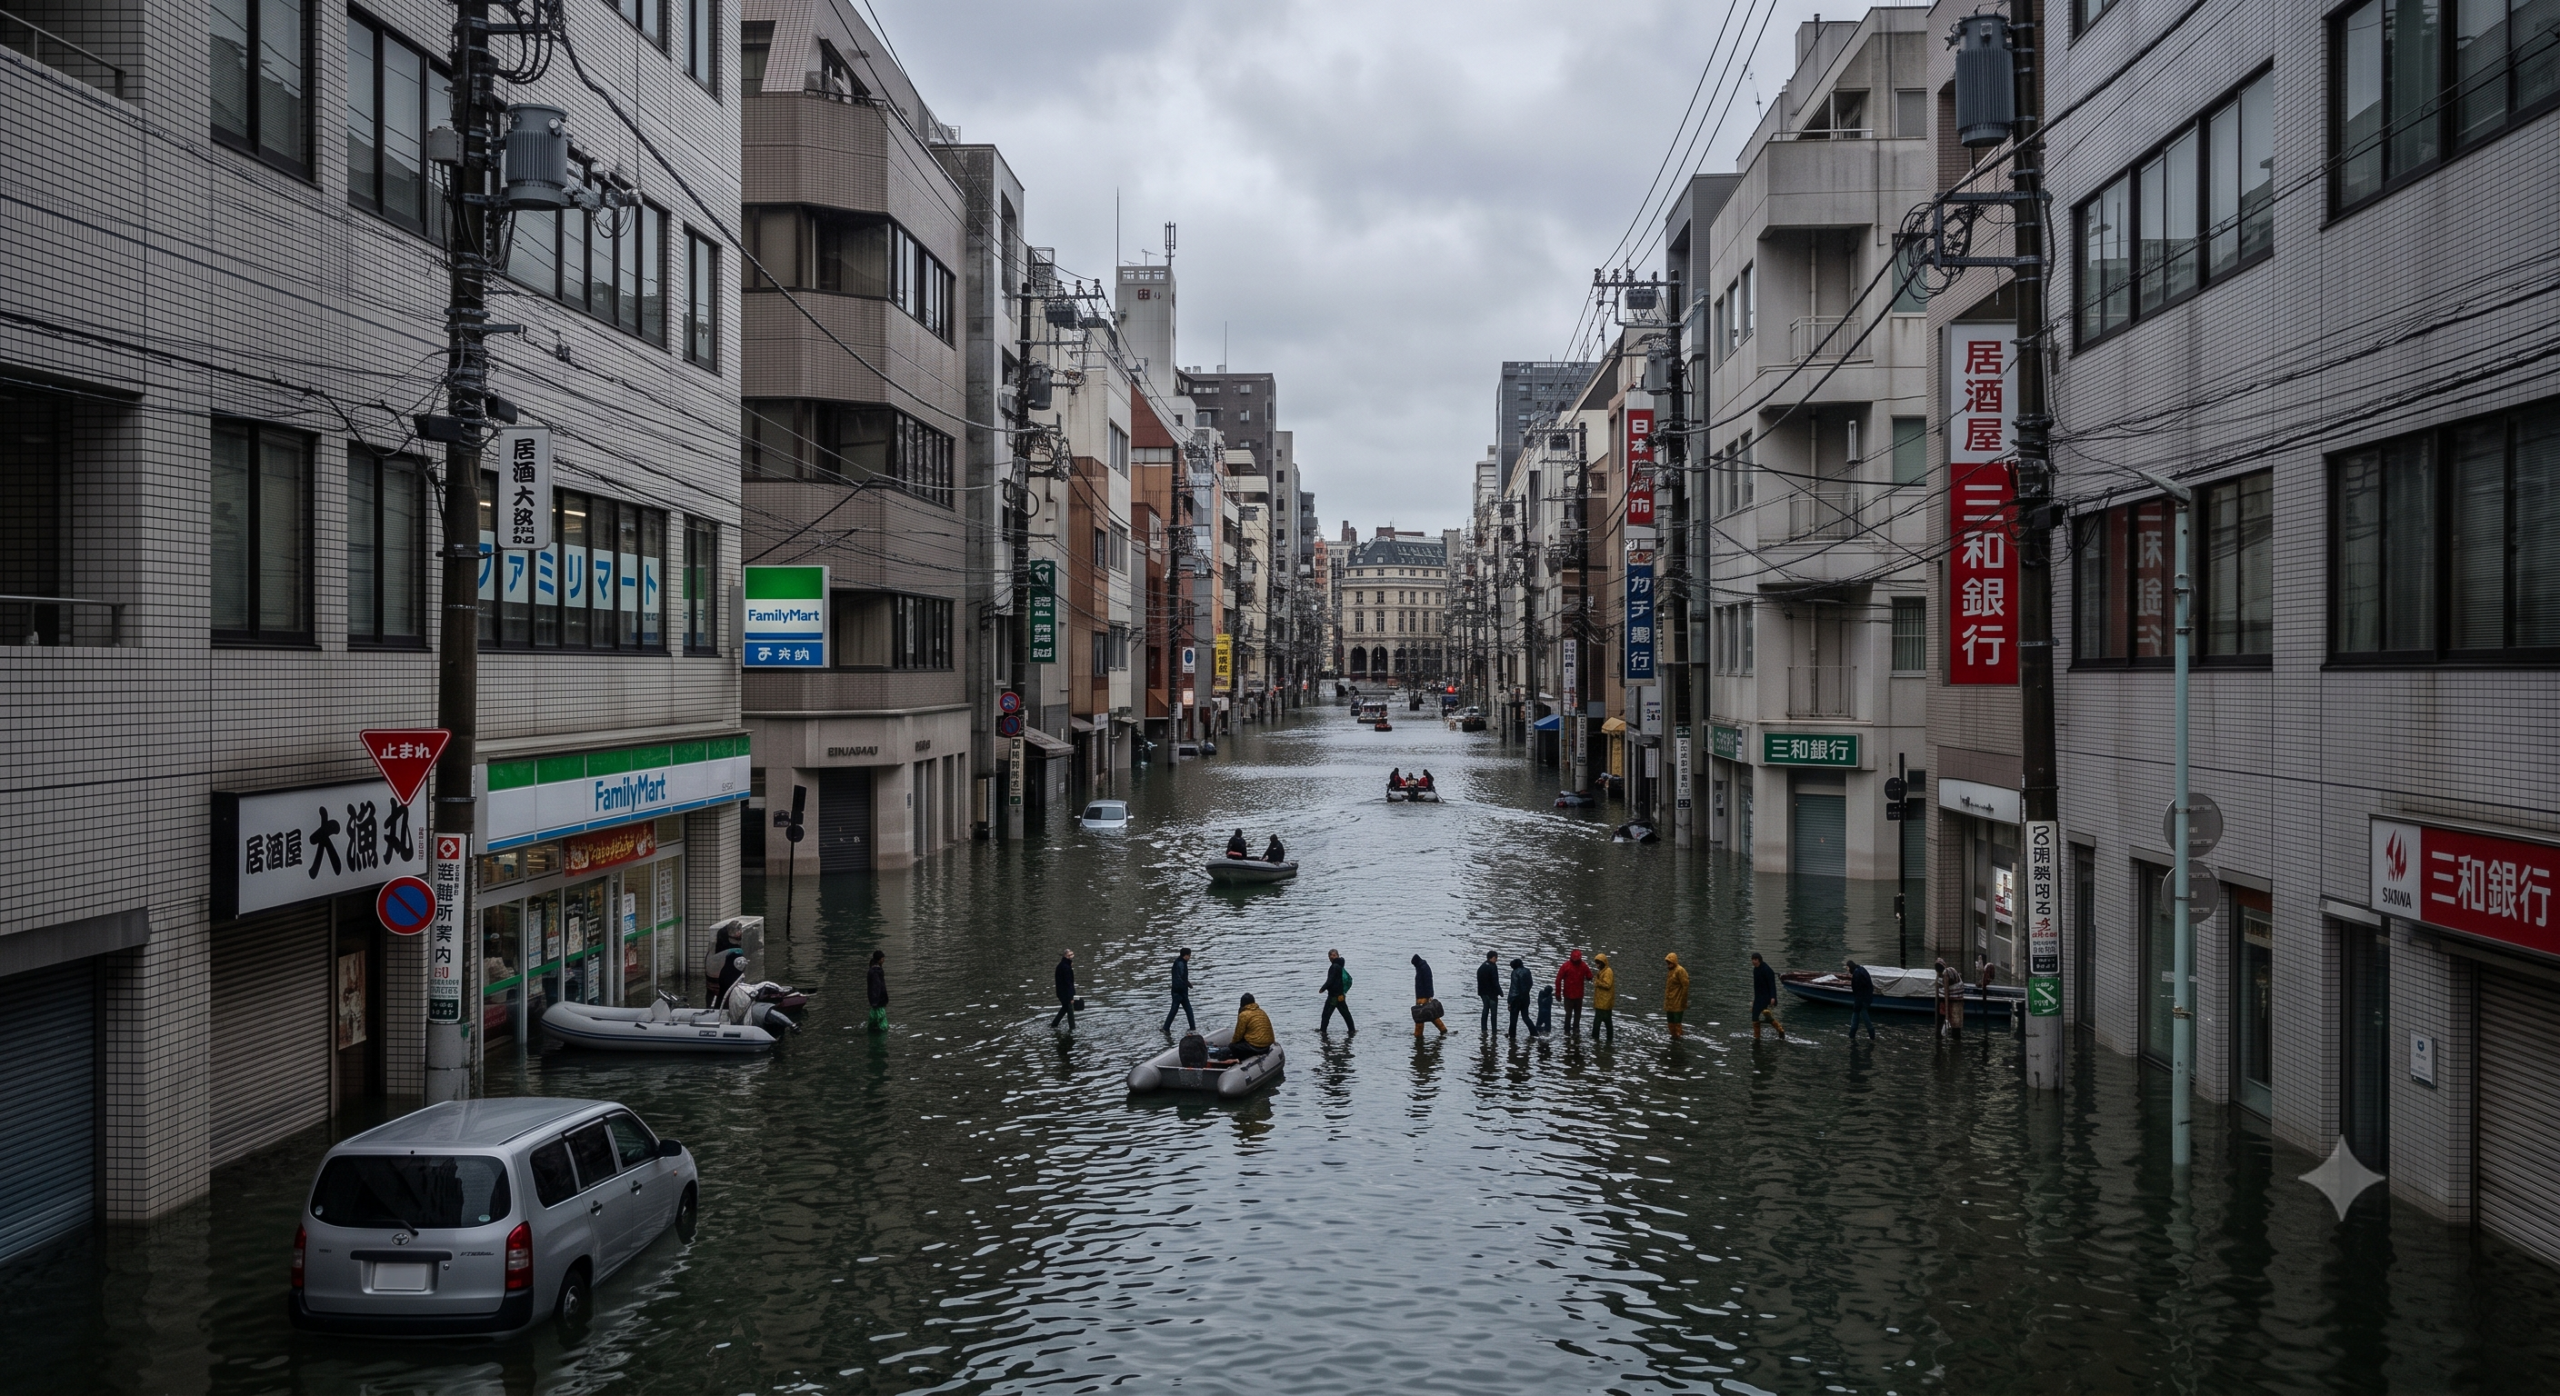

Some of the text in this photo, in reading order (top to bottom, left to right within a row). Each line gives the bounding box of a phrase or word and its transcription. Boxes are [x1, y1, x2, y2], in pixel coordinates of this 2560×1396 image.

[1964, 340, 2004, 451] 居酒屋
[1962, 485, 2005, 665] 三和銀行
[748, 609, 819, 623] FamilyMart
[380, 742, 431, 759] 止まれ
[1771, 739, 1849, 760] 三和銀行
[595, 772, 666, 812] FamilyMart
[246, 828, 302, 875] 居酒屋
[308, 797, 414, 880] 大漁丸
[2431, 850, 2551, 927] 三和銀行
